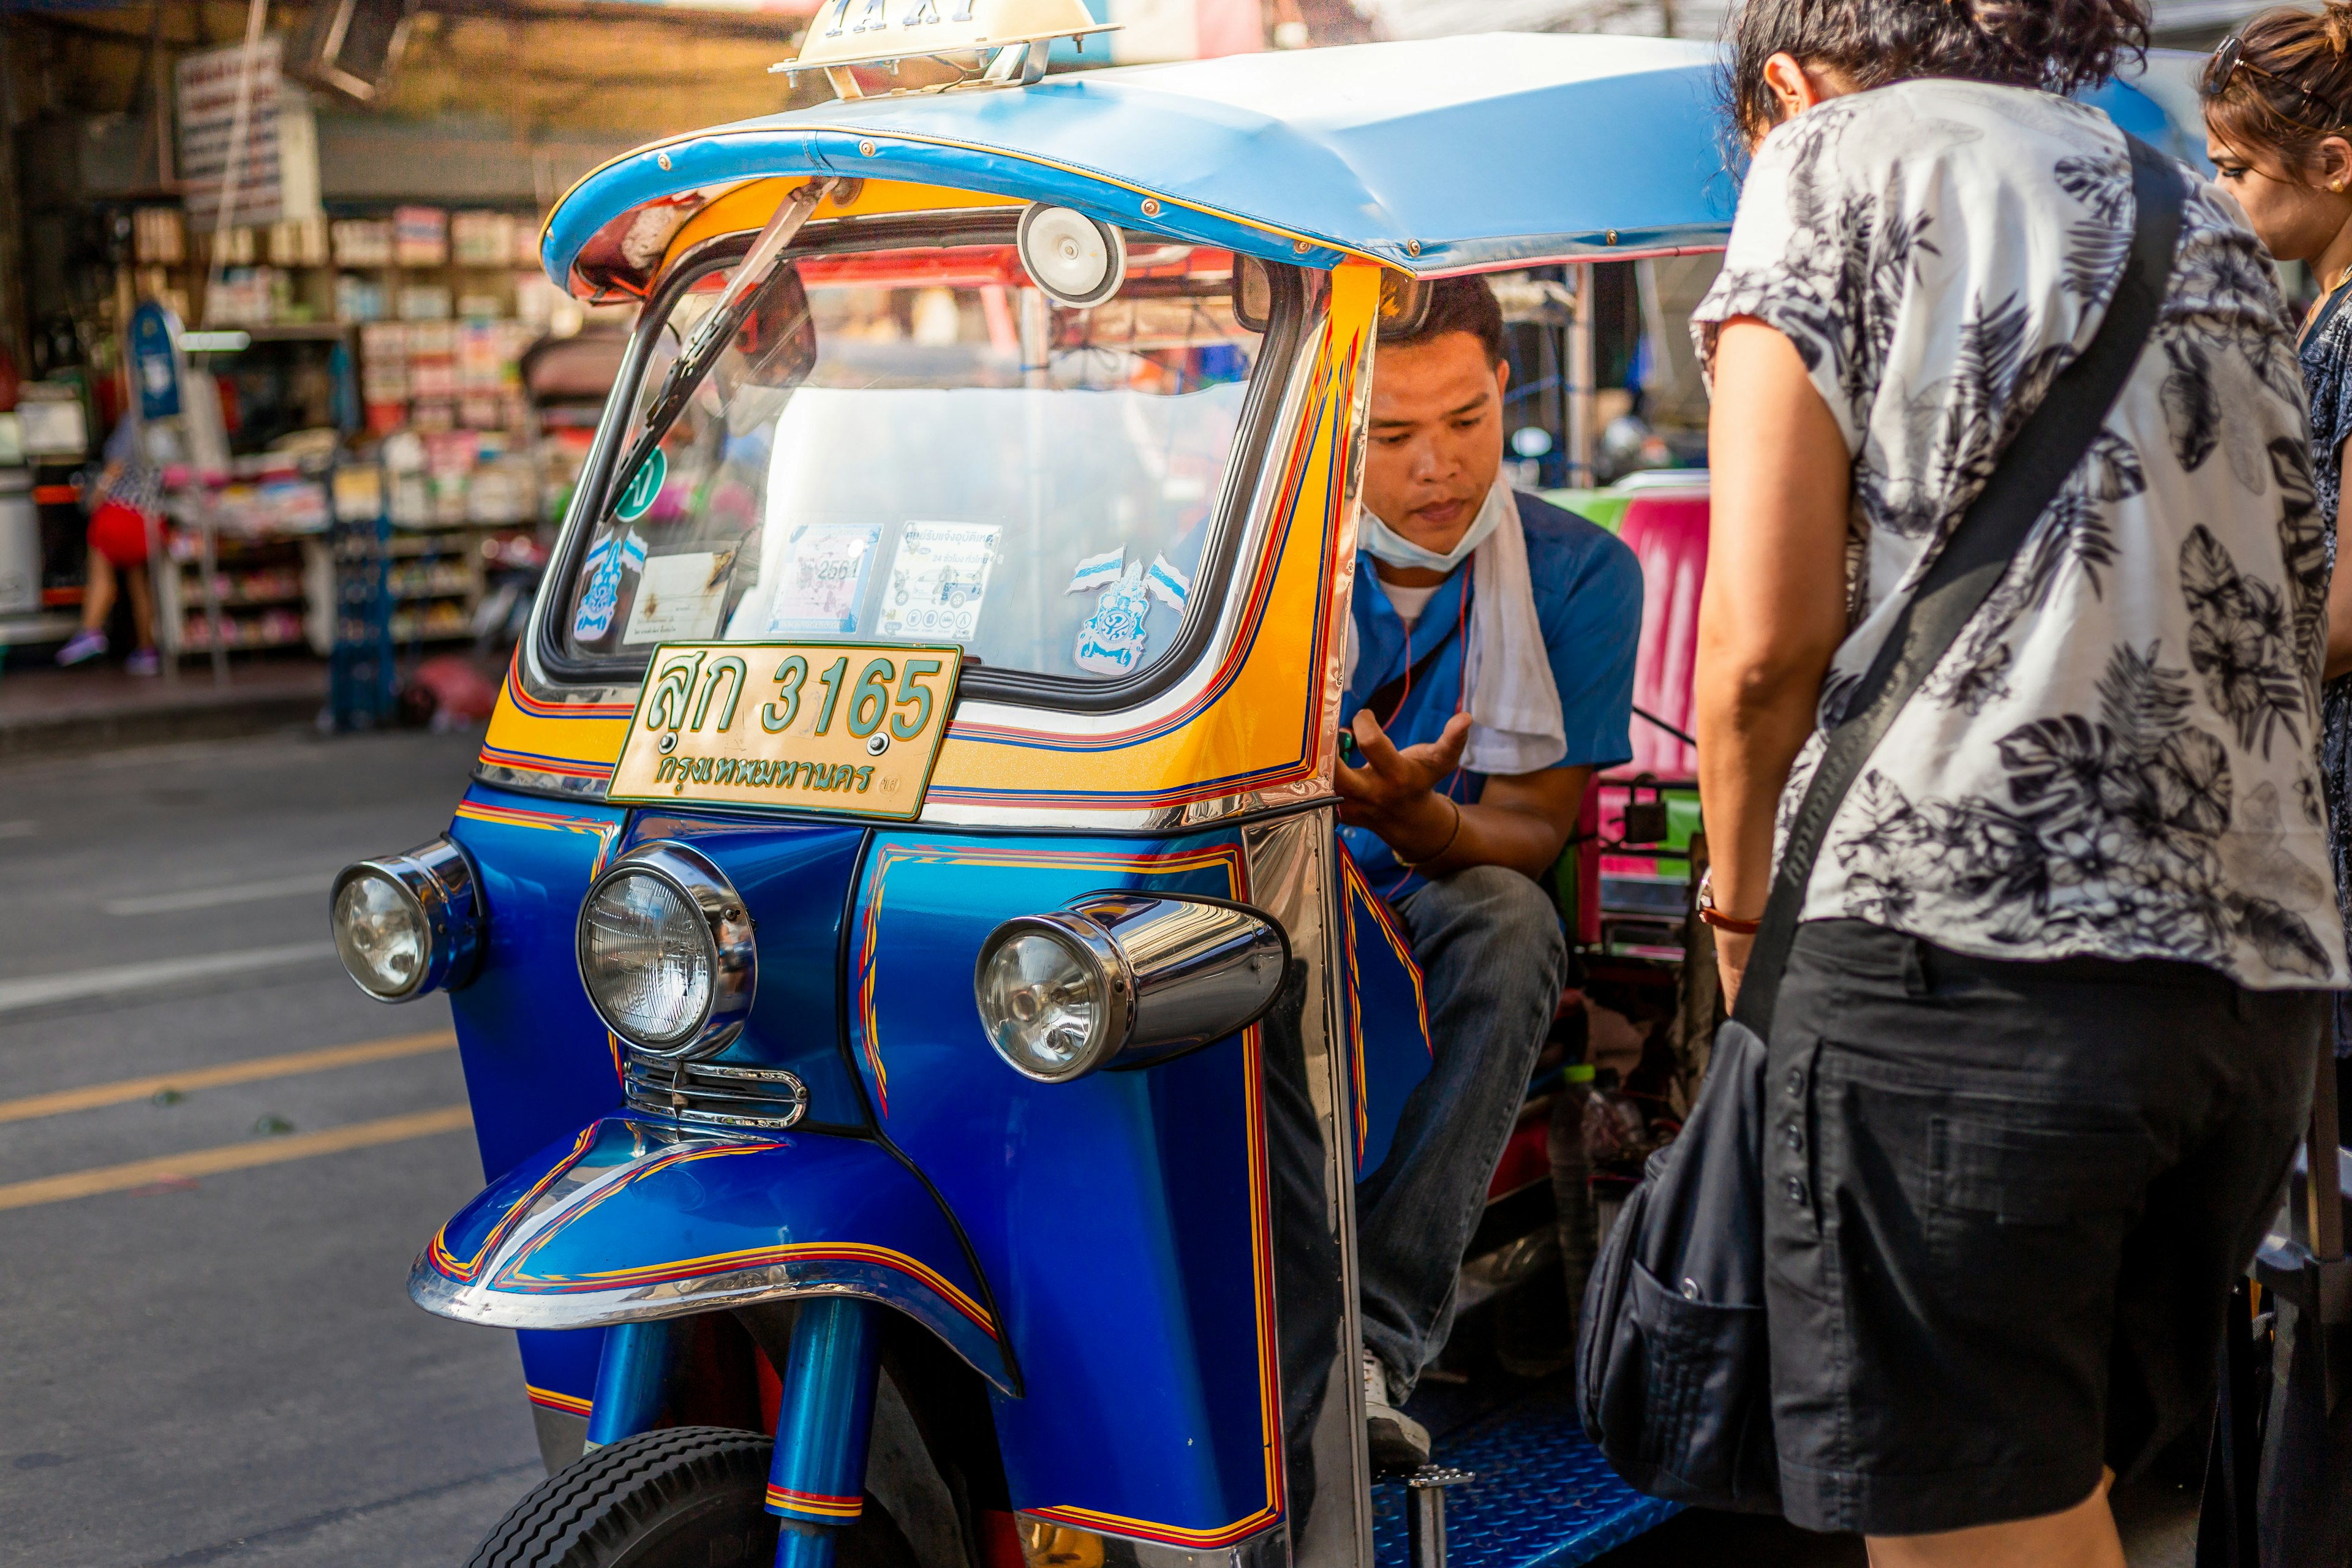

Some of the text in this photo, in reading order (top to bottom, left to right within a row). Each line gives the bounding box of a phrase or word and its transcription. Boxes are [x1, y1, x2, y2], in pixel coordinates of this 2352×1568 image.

[818, 556, 861, 580] 2561
[761, 655, 943, 741] 3165
[656, 755, 875, 796] กรุงเทพมหานคร
